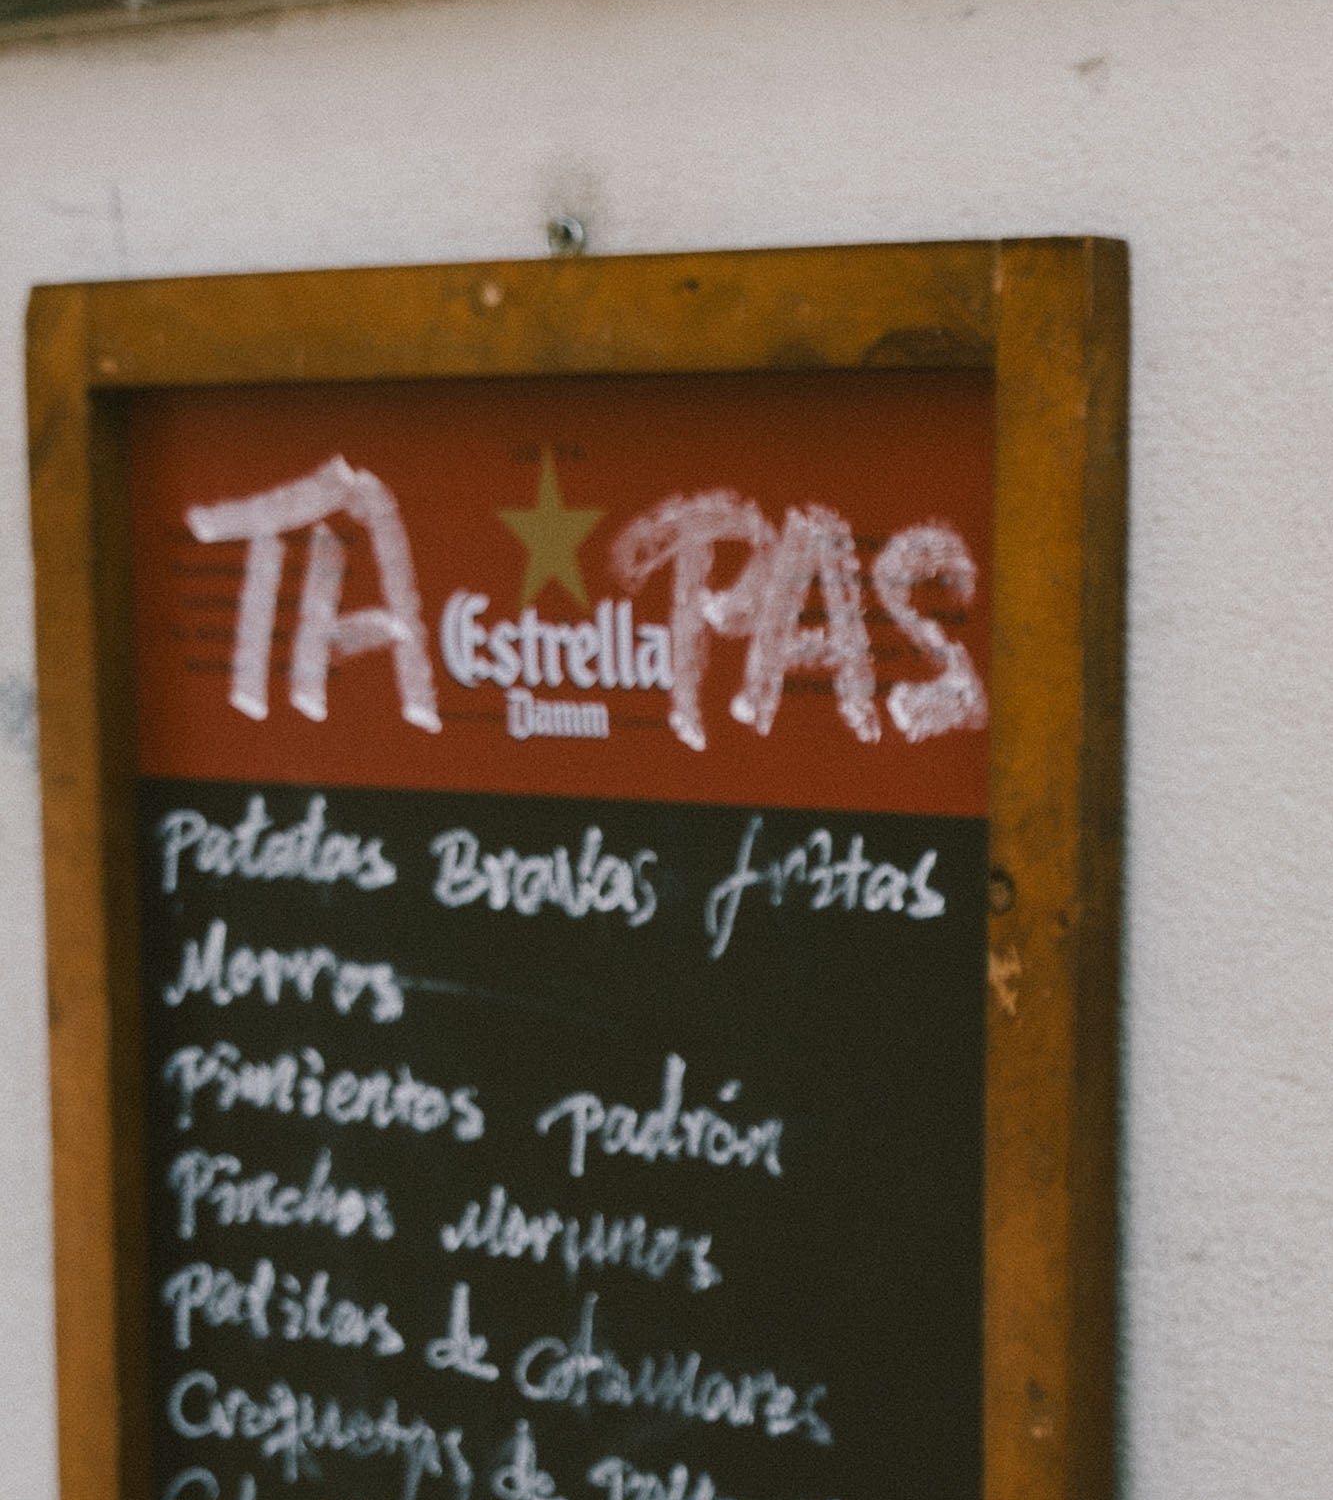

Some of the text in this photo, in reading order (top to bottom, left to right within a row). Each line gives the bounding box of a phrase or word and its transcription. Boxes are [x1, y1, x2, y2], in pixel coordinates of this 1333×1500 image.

[440, 589, 672, 692] Estrella
[506, 686, 610, 740] Damm
[163, 919, 405, 1023] Morros
[425, 1280, 501, 1383] de
